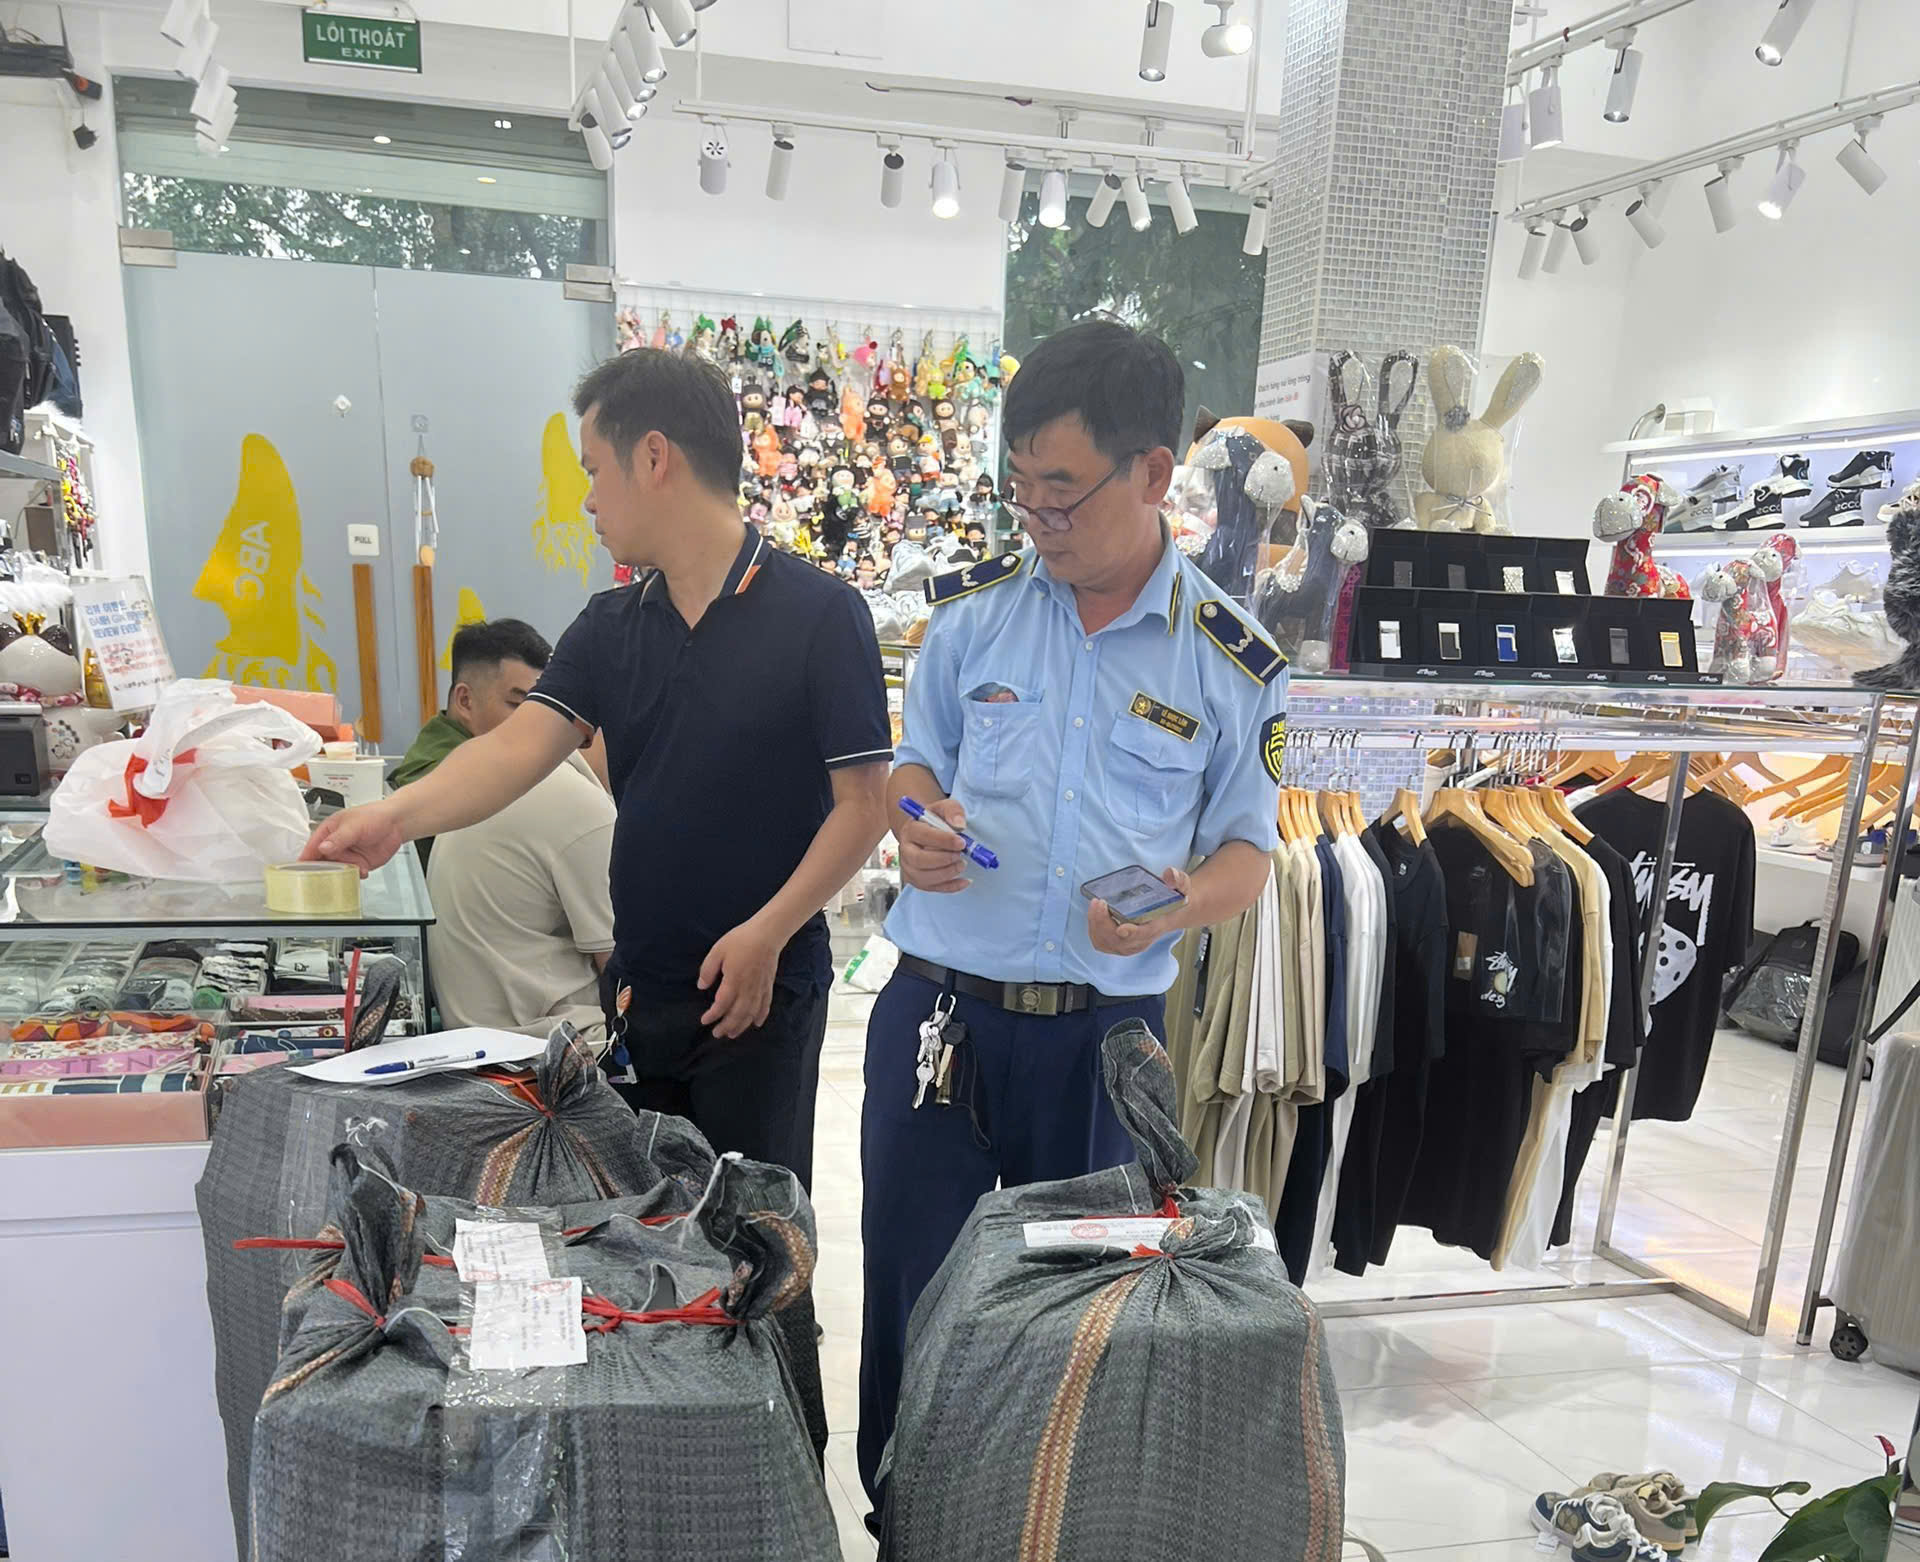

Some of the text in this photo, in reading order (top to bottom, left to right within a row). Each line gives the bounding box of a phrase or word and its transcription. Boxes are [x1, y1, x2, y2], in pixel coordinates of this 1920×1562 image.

[348, 27, 406, 49] THOÁT
[341, 47, 383, 60] EXIT
[354, 536, 372, 545] PULL
